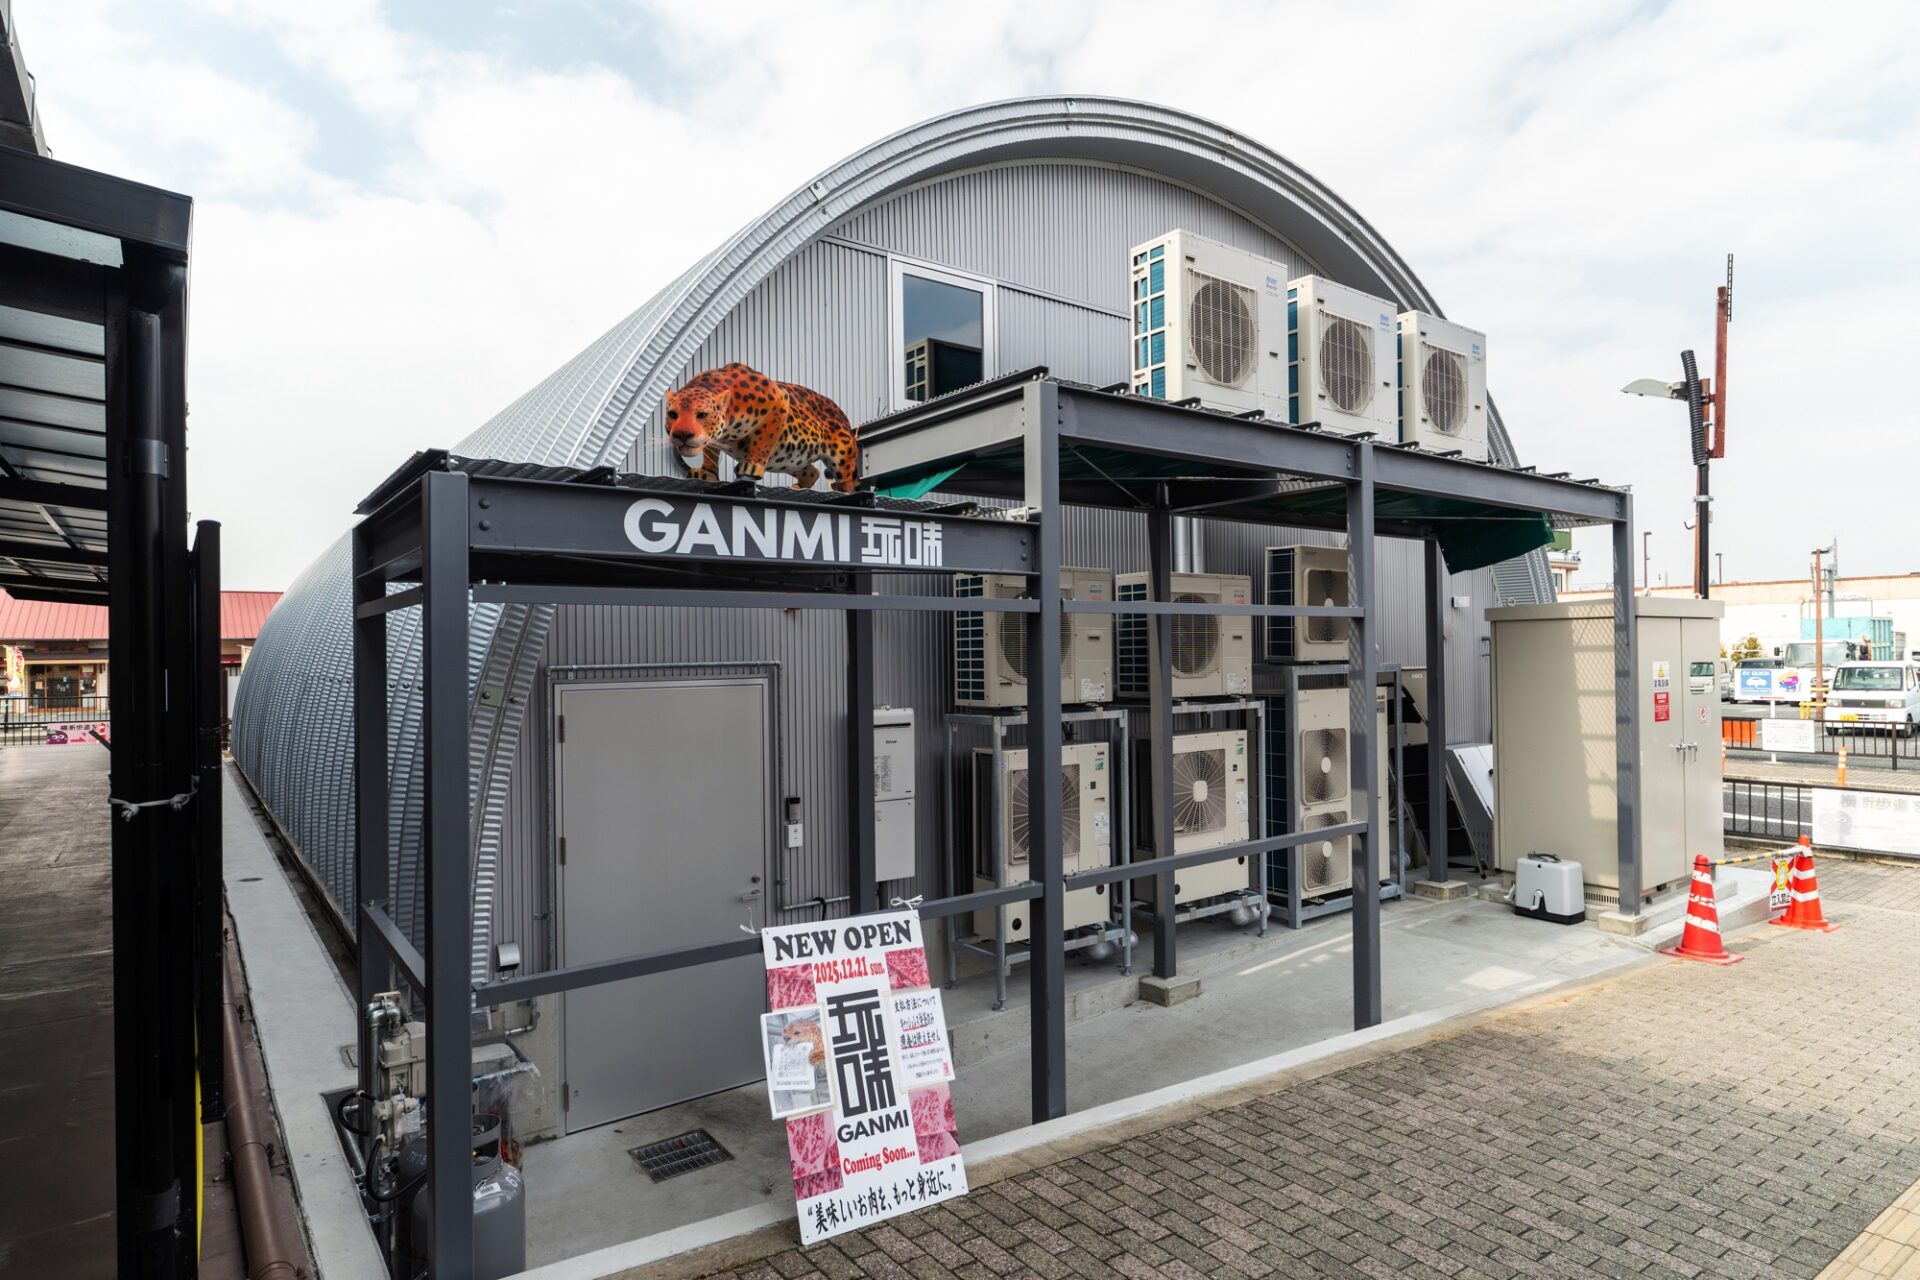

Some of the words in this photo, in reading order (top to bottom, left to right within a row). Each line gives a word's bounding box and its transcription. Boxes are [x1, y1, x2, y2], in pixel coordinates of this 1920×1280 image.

[624, 498, 850, 562] GANMI
[861, 516, 943, 567] 玩味
[772, 929, 837, 961] NEW
[843, 920, 912, 951] OPEN
[814, 956, 869, 984] 2025.12.21
[826, 989, 897, 1118] 玩味
[837, 1109, 910, 1143] GANMI
[843, 1152, 882, 1175] Coming
[882, 1147, 916, 1164] Soon...
